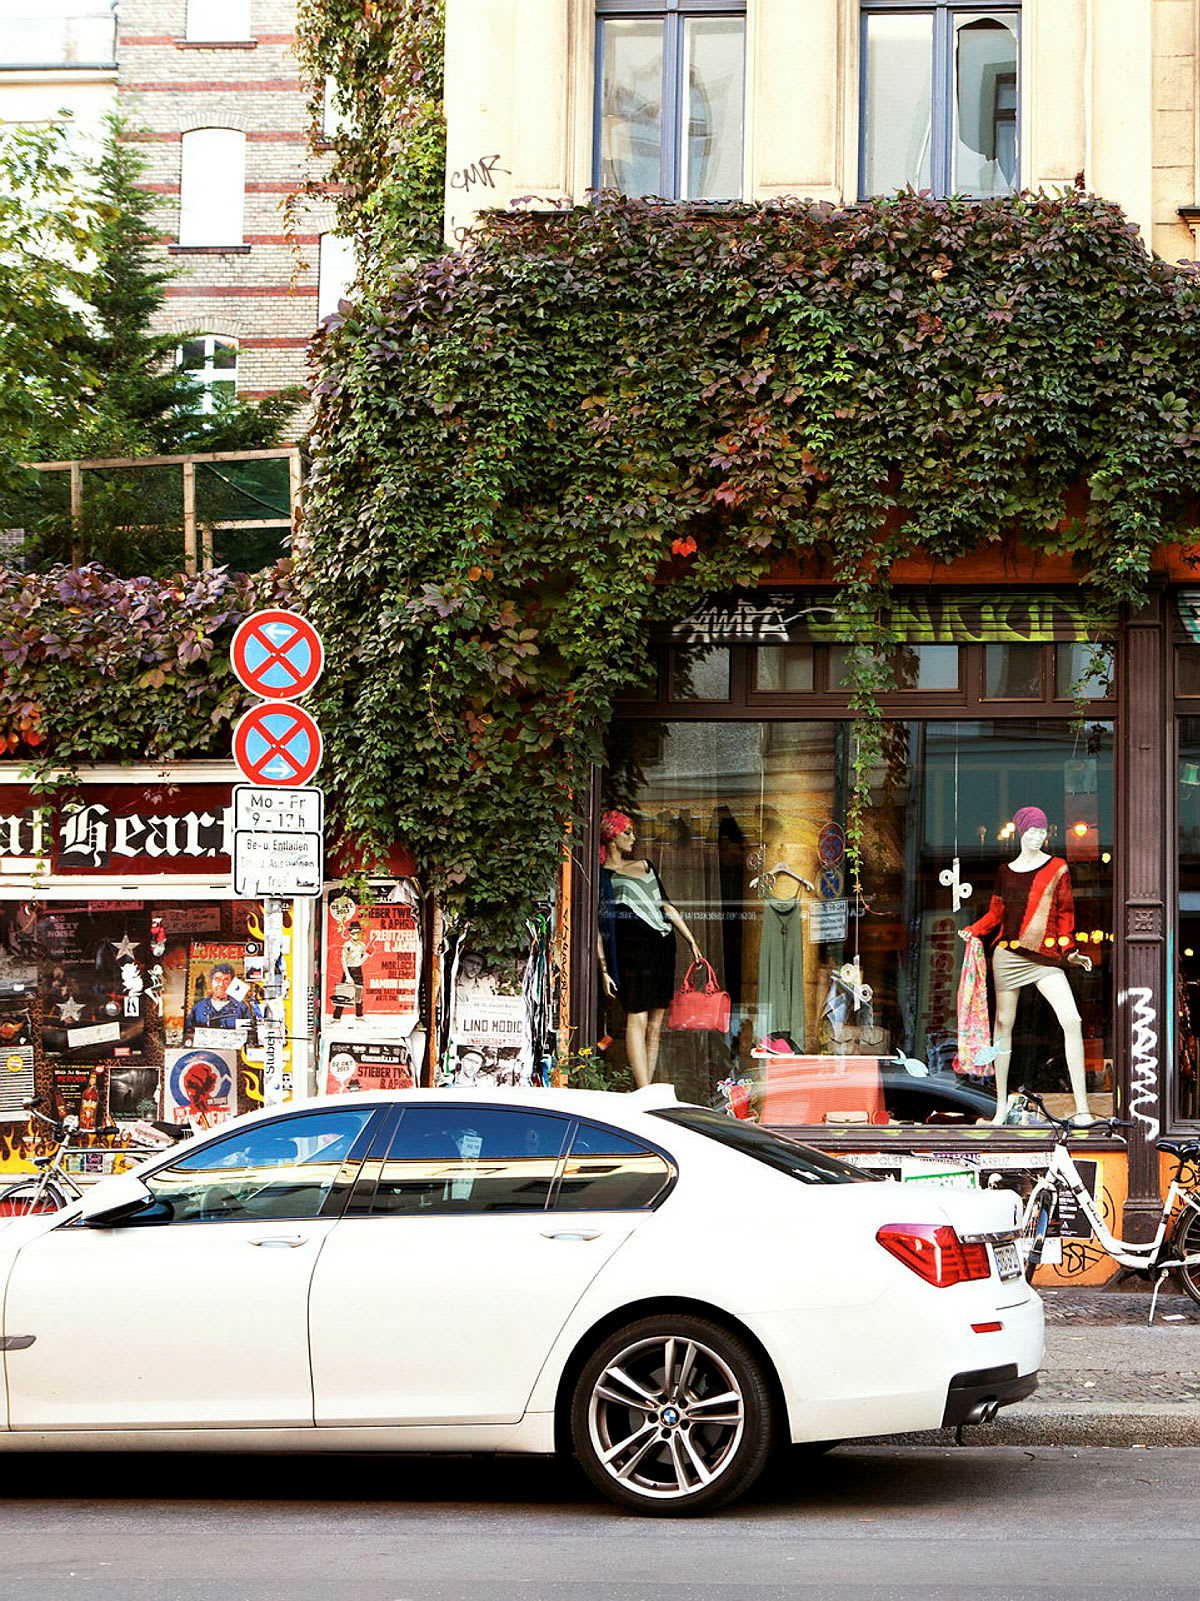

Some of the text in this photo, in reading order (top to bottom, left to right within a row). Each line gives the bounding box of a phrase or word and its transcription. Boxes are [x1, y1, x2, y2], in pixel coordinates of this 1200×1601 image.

[250, 794, 273, 808] Mo
[290, 794, 306, 809] Fr
[252, 812, 260, 826] 9
[298, 815, 305, 828] h
[463, 1019, 488, 1032] LINO
